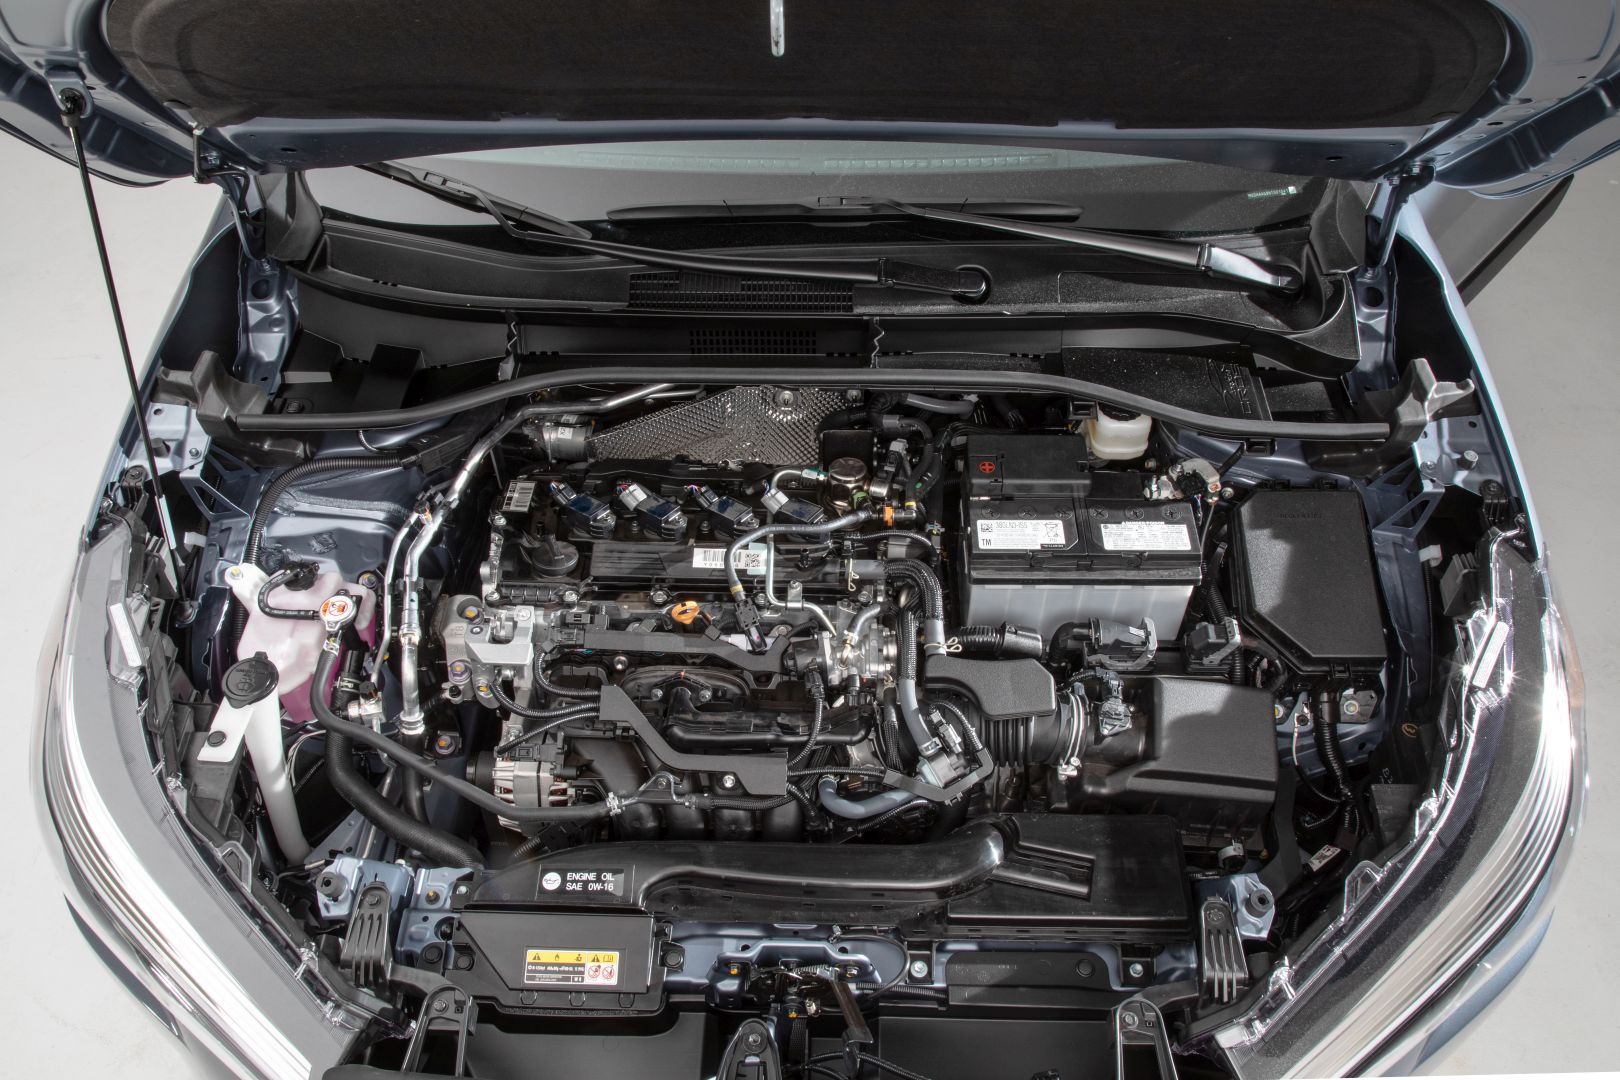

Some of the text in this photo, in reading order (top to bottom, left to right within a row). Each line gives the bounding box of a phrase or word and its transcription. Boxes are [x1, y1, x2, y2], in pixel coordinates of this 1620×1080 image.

[981, 538, 992, 547] TM
[566, 872, 615, 881] ENGINE OIL
[565, 882, 614, 891] SAE 0W-16
